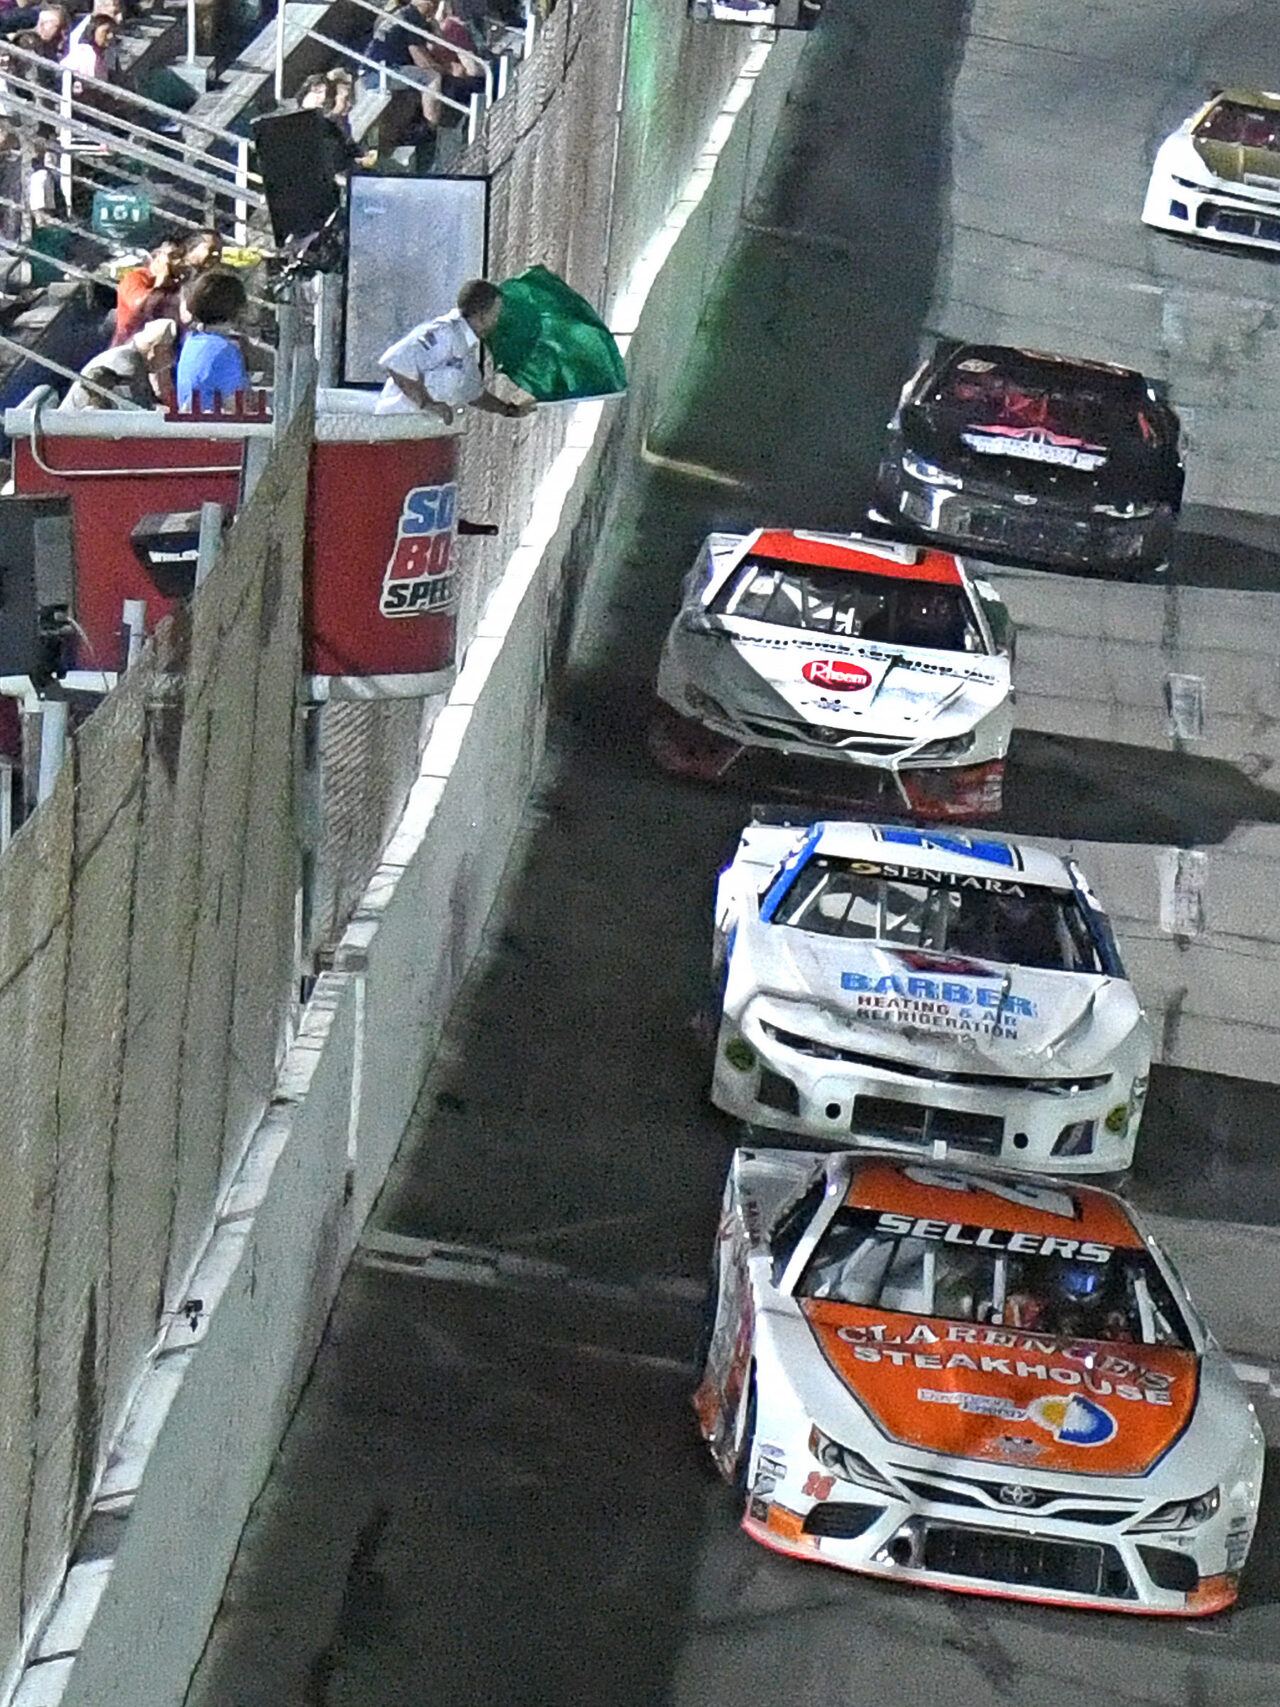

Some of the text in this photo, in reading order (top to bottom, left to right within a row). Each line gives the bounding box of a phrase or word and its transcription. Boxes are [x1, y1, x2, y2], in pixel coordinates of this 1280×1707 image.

[883, 864, 1026, 899] SENTARA
[840, 971, 1038, 1018] BARBER
[857, 995, 950, 1016] HEATING
[857, 1008, 1018, 1040] REFRIGERATION
[875, 1212, 1115, 1264] SELLERS
[854, 1346, 1174, 1406] STEAKHOUSE
